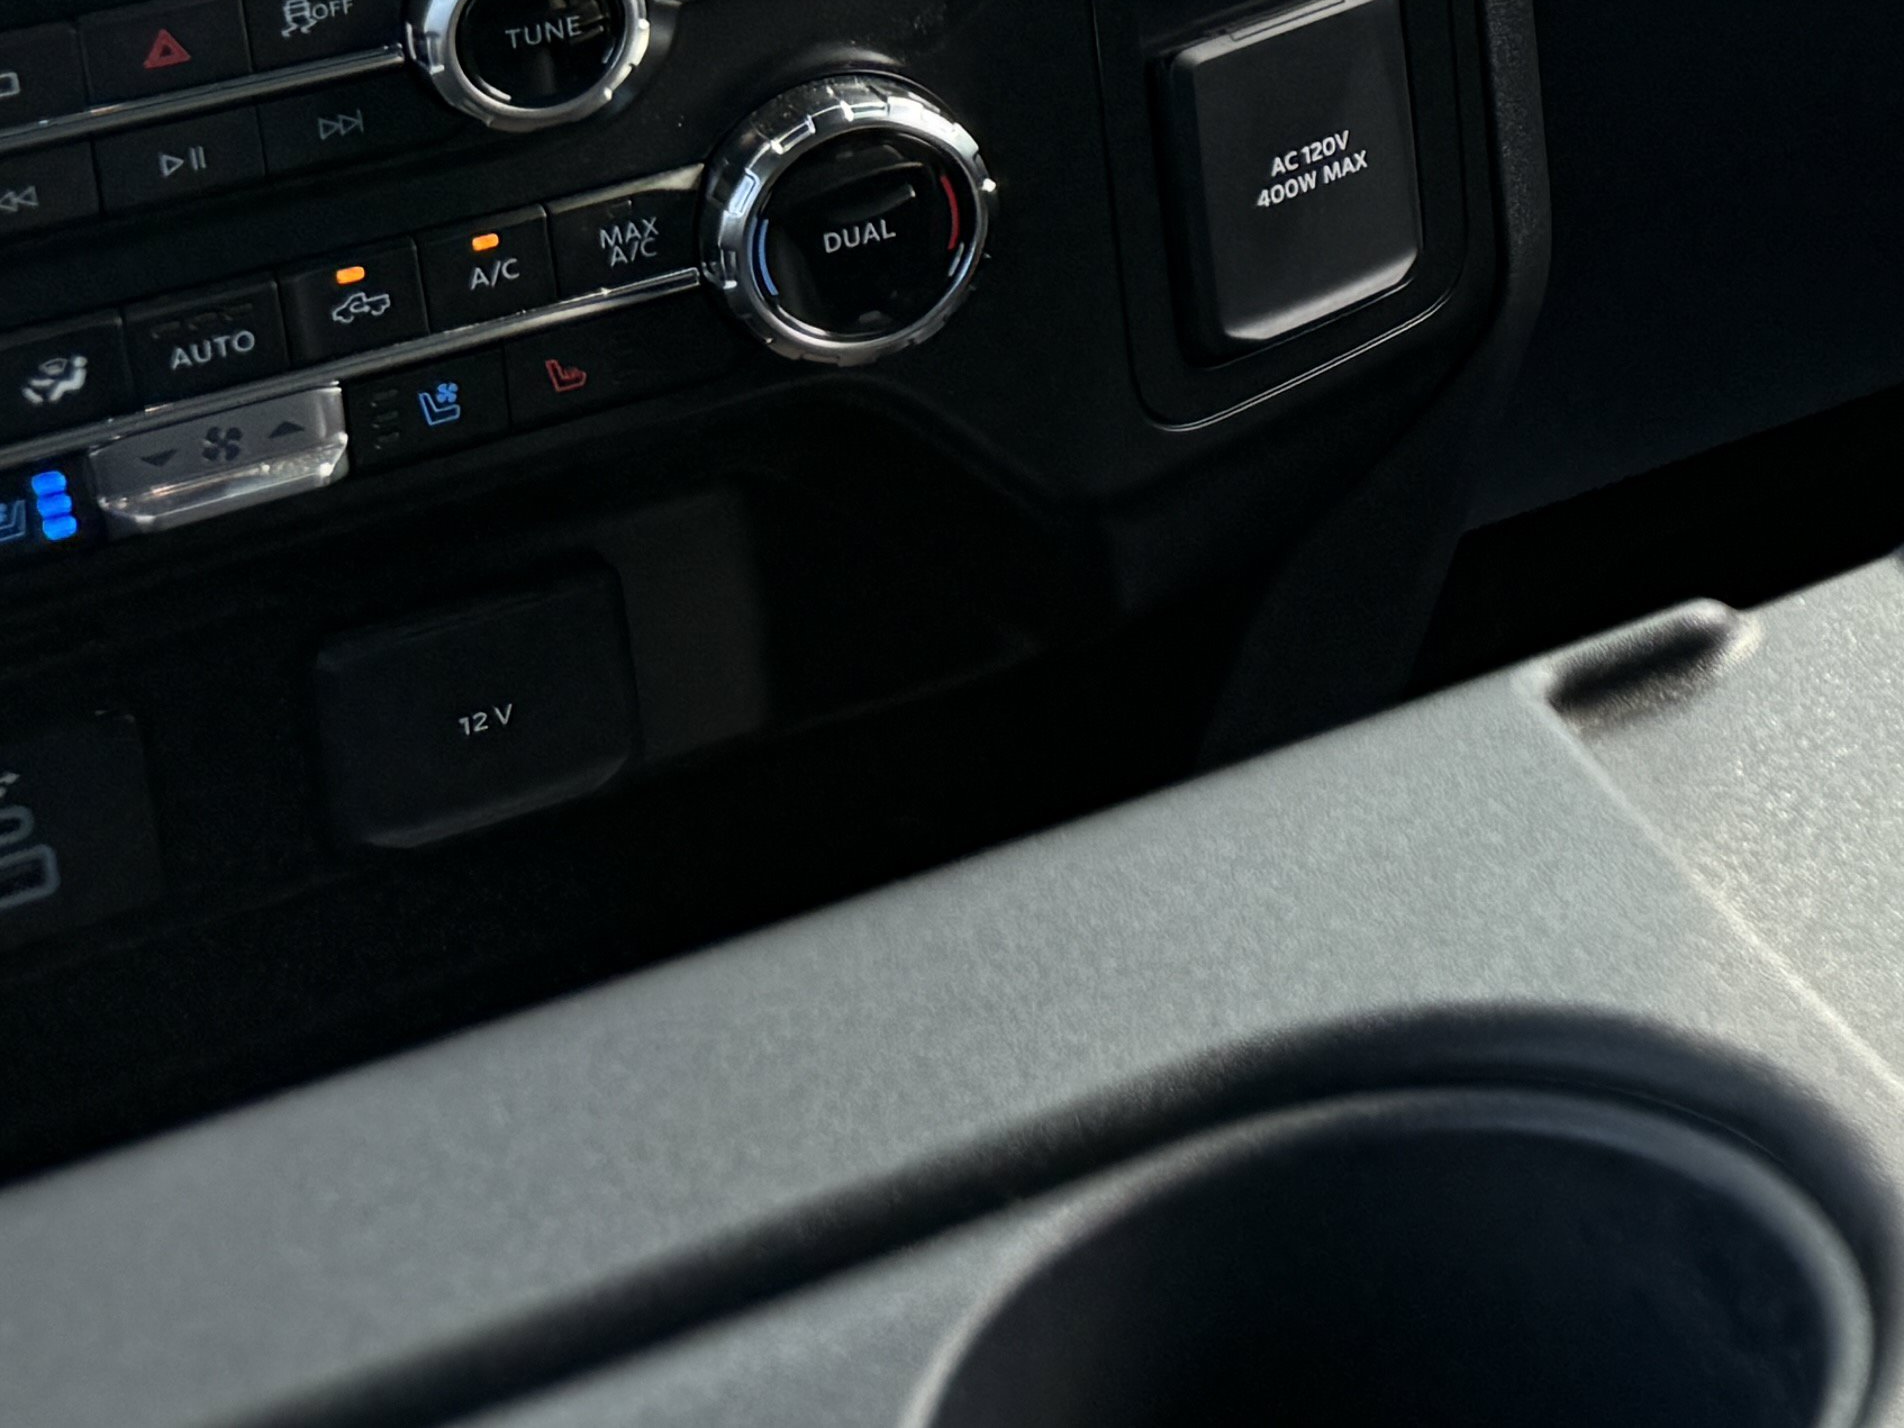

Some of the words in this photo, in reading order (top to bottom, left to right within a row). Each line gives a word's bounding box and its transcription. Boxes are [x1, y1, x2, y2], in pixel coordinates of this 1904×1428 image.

[504, 14, 582, 49] TUNE
[1270, 149, 1300, 178] AC
[1300, 128, 1350, 166] 120V
[1256, 170, 1318, 209] 400W
[1321, 148, 1368, 185] MAX
[600, 216, 660, 249] MAX
[823, 219, 898, 254] DUAL
[610, 235, 658, 268] A/C
[468, 257, 521, 291] A/C
[169, 330, 256, 372] AUTO
[458, 711, 489, 737] 12
[492, 702, 513, 726] V
